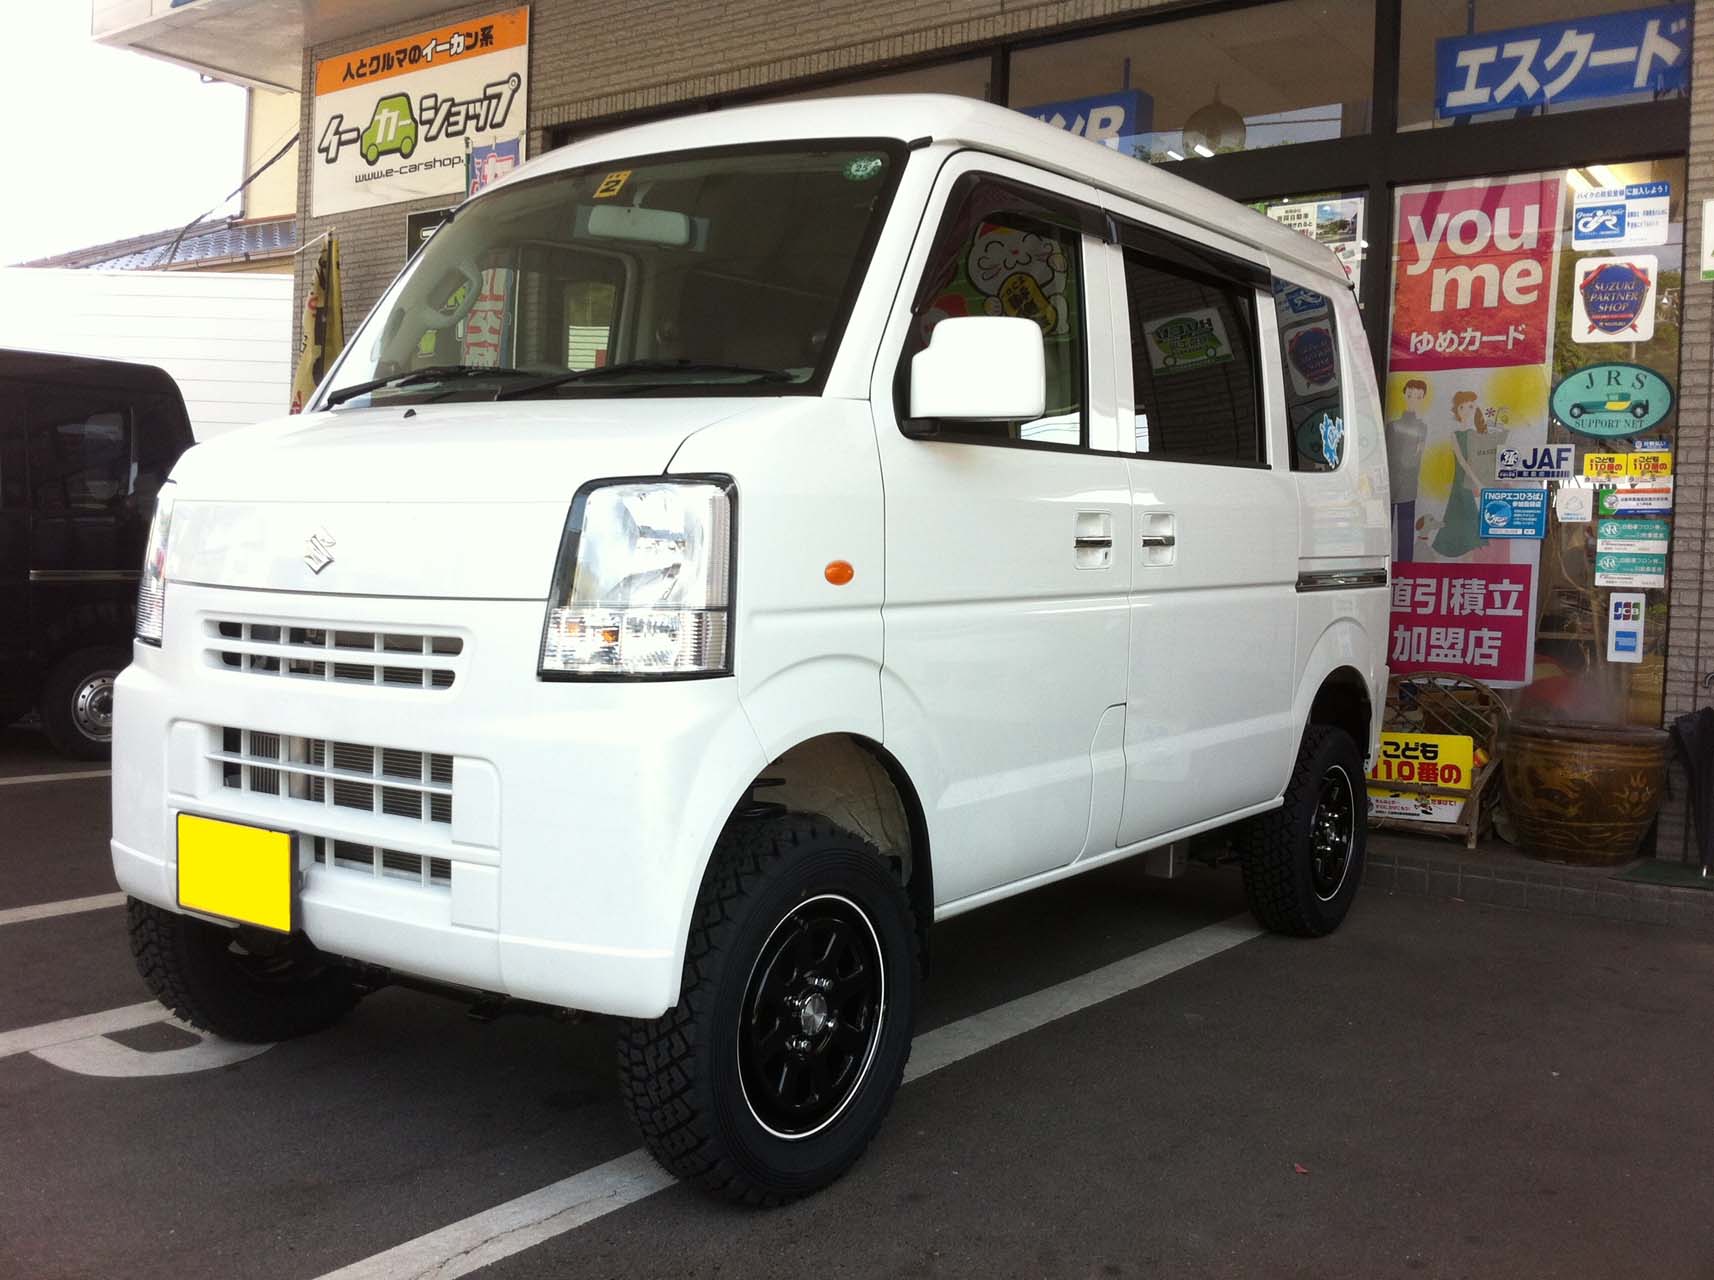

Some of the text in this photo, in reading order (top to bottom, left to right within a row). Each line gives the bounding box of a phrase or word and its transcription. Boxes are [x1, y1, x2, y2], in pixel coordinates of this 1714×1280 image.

[342, 24, 494, 82] 人とクルマのイーカン系
[1445, 18, 1686, 108] エスクード
[1406, 203, 1541, 276] you
[1430, 258, 1544, 313] me
[1590, 290, 1640, 302] PARTNER
[1593, 281, 1637, 292] SUZUKI
[1598, 302, 1629, 312] SHOP
[1409, 323, 1527, 354] ゆめカード
[1574, 418, 1645, 430] SUPPORT NET
[1521, 446, 1572, 471] JAF
[1392, 624, 1502, 667] 加盟店
[1382, 740, 1439, 761] こども
